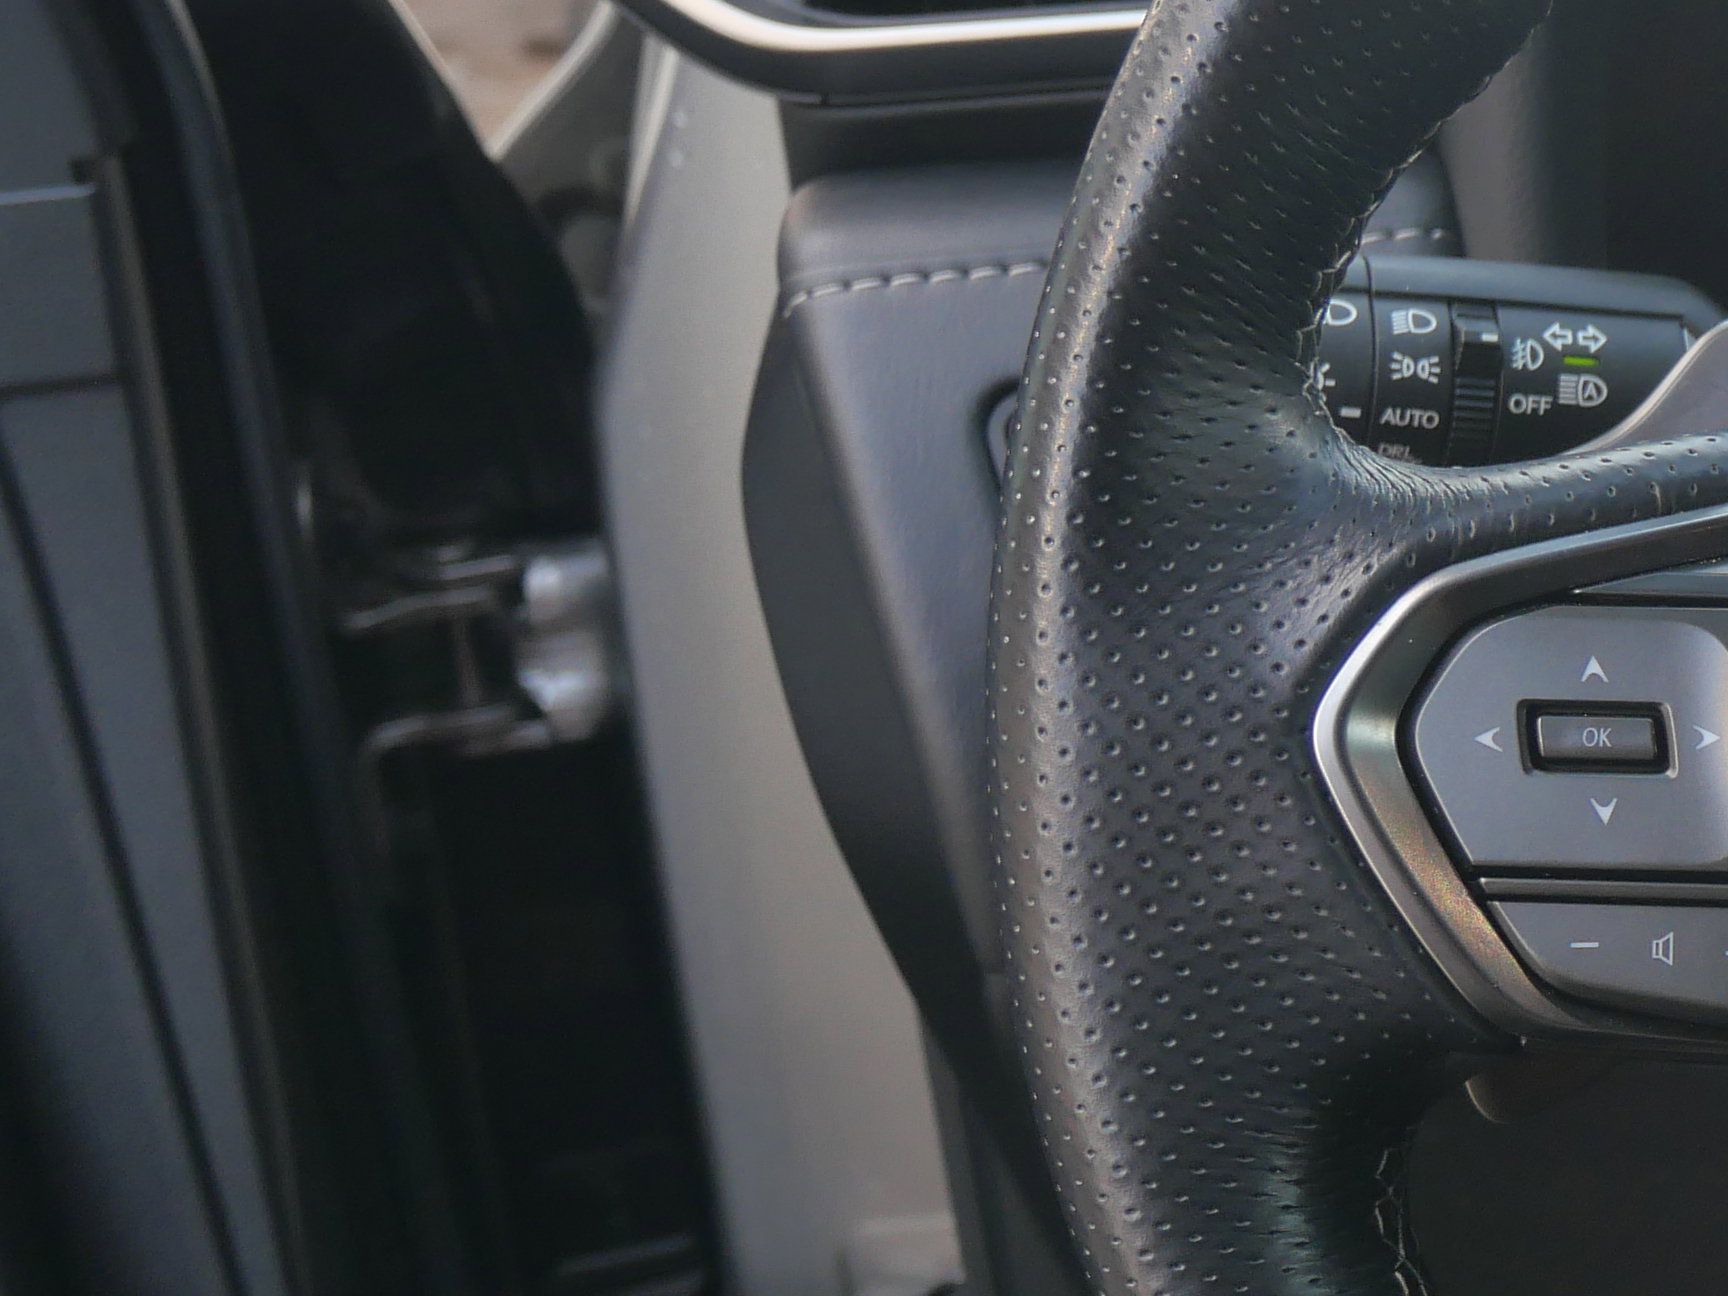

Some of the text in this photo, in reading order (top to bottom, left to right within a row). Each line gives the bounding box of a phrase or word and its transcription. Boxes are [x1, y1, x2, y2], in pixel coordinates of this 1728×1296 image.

[1509, 393, 1553, 417] OFF
[1380, 406, 1440, 430] AUTO
[1582, 727, 1612, 749] OK
